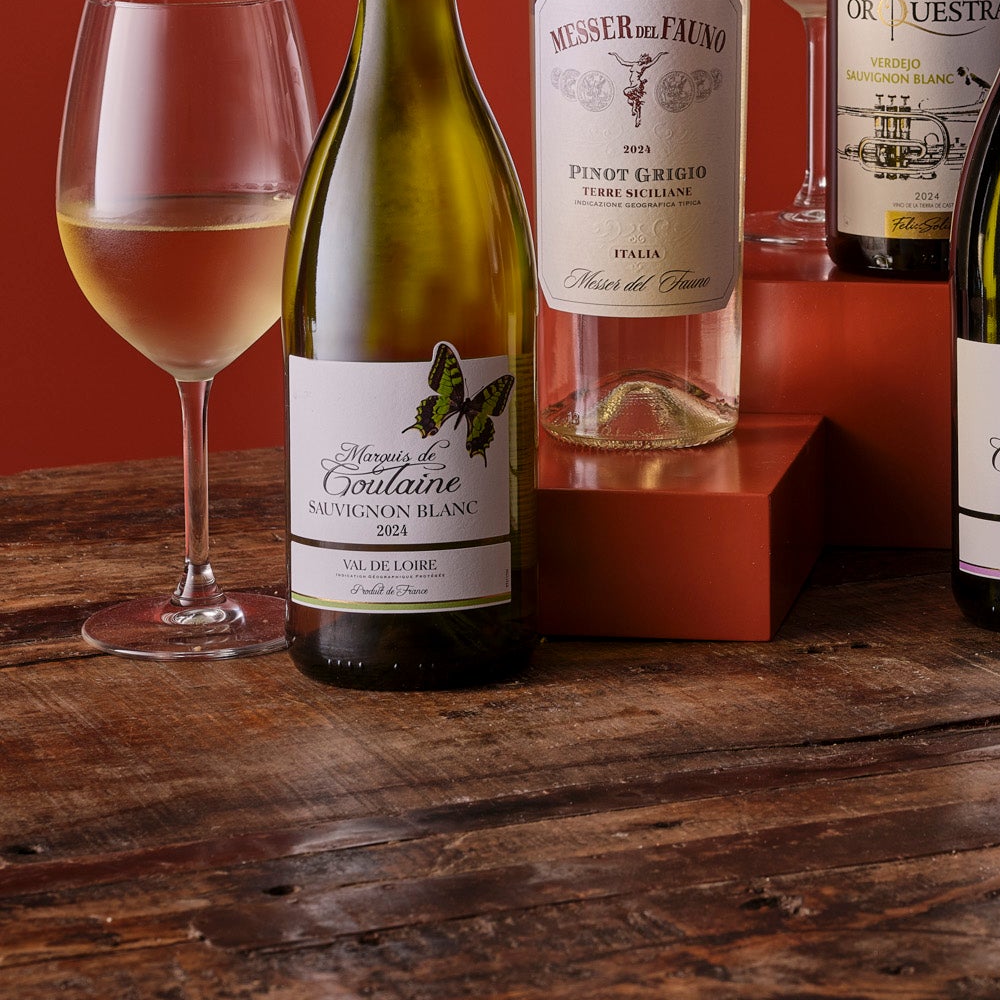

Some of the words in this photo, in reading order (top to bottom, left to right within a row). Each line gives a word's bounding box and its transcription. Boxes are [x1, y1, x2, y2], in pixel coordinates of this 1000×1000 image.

[550, 15, 633, 54] MESSER
[635, 26, 659, 39] DEL
[660, 15, 727, 54] FAUNO
[870, 56, 921, 70] VERDEJO
[846, 69, 910, 85] SAUVIGNON
[913, 70, 954, 85] BLANC
[623, 145, 651, 154] 2024
[569, 164, 629, 181] PINOT
[634, 165, 707, 183] GRIGIO
[582, 186, 622, 198] TERRE
[626, 187, 692, 198] SICILIANE
[915, 192, 939, 200] 2024
[574, 199, 622, 208] INDICAZIONE
[625, 200, 676, 208] GEOGRAFICA
[614, 248, 660, 259] ITALIA
[563, 268, 620, 292] Messer
[624, 274, 654, 293] del
[658, 269, 711, 294] Fauno
[335, 442, 413, 473] Marquis
[418, 439, 450, 462] de
[308, 500, 410, 519] SAUVIGNON
[417, 500, 478, 518] BLANC
[376, 524, 408, 537] 2024
[343, 559, 366, 571] VAL
[370, 560, 390, 571] DE
[394, 559, 438, 571] LOIRE
[350, 583, 385, 595] Produit
[386, 586, 395, 595] de
[396, 584, 428, 597] France
